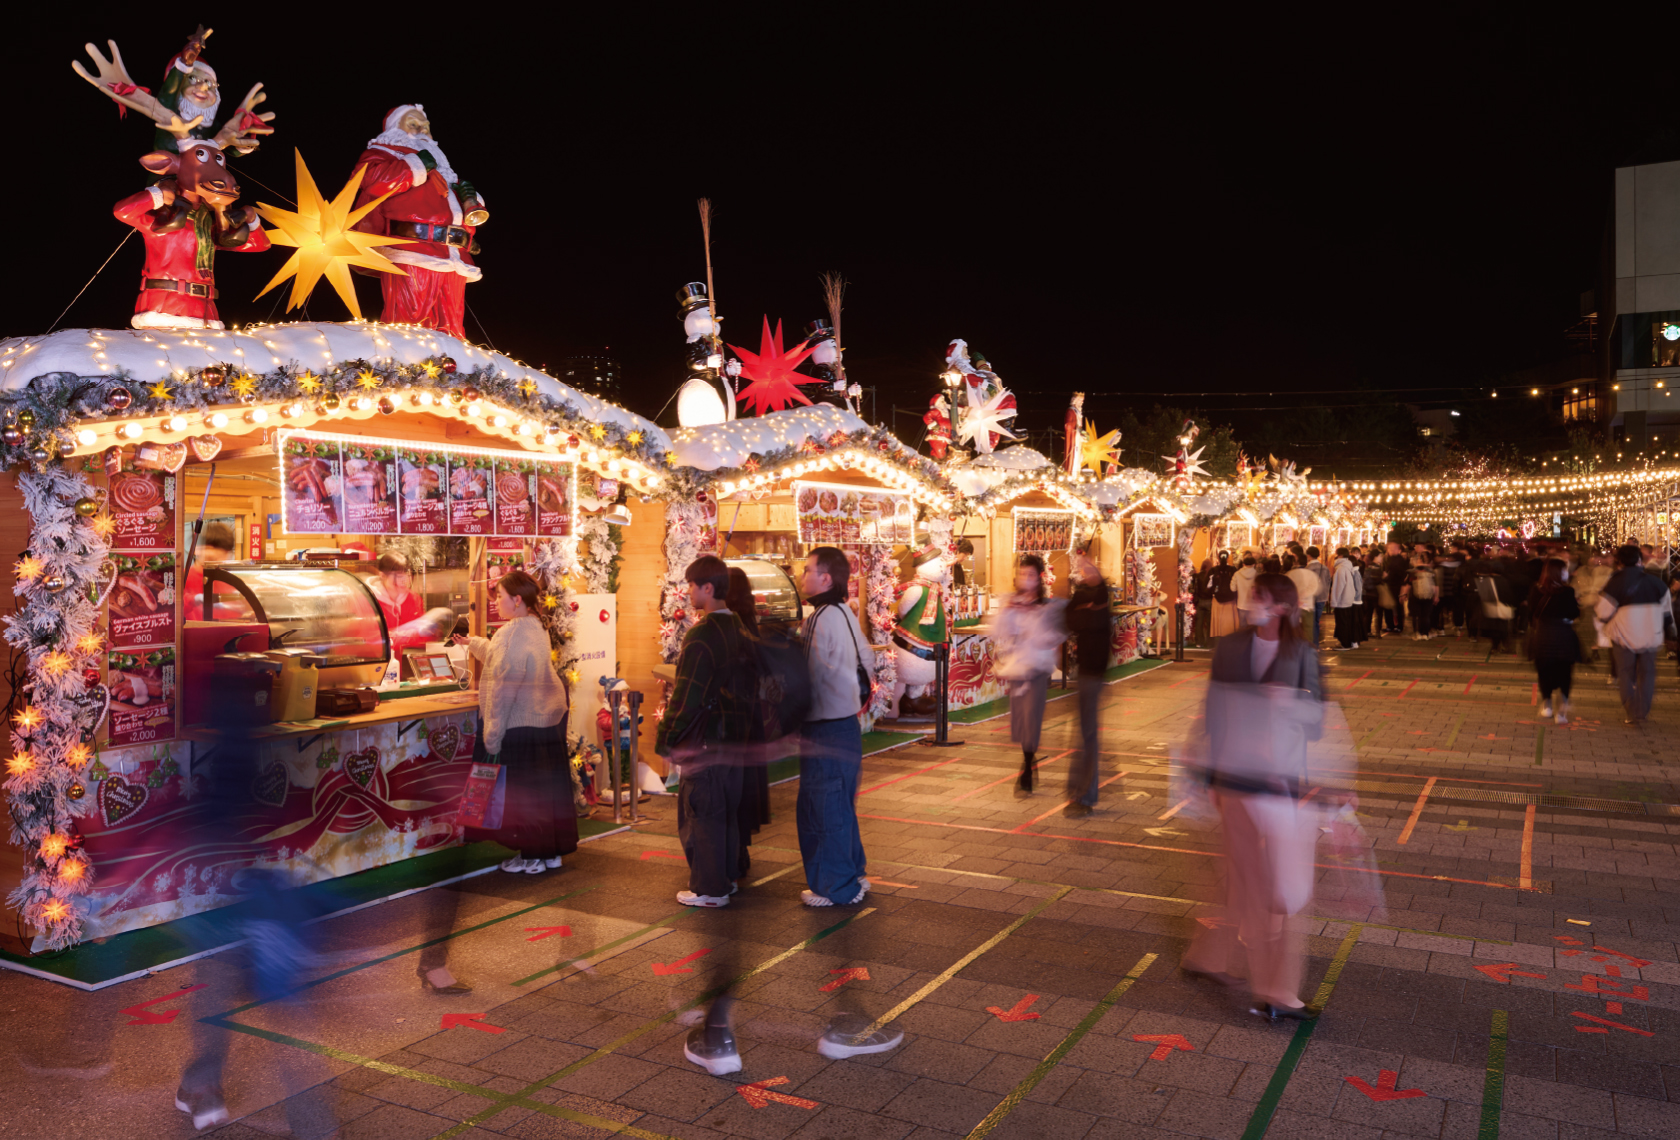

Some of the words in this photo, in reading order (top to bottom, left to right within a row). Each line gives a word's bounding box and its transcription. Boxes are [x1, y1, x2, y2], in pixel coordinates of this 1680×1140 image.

[296, 503, 331, 514] チョリソー
[348, 507, 396, 518] ニュルンベルガー
[405, 502, 445, 512] ソーセージ2種
[116, 518, 145, 526] ぐるぐる
[501, 514, 526, 523] ソーセージ
[541, 514, 571, 525] フランクフルト
[118, 523, 157, 534] ソーセージ
[130, 537, 155, 547] ¥1,600
[252, 526, 260, 557] 消火器
[113, 617, 134, 625] German
[114, 617, 172, 634] ヴァイスブルスト
[134, 634, 152, 643] ¥900
[114, 706, 169, 725] ソーセージ2種
[115, 720, 144, 732] 盛り合わせ
[130, 730, 156, 742] ¥2,000
[116, 786, 132, 799] Merry
[106, 791, 135, 808] Christmas
